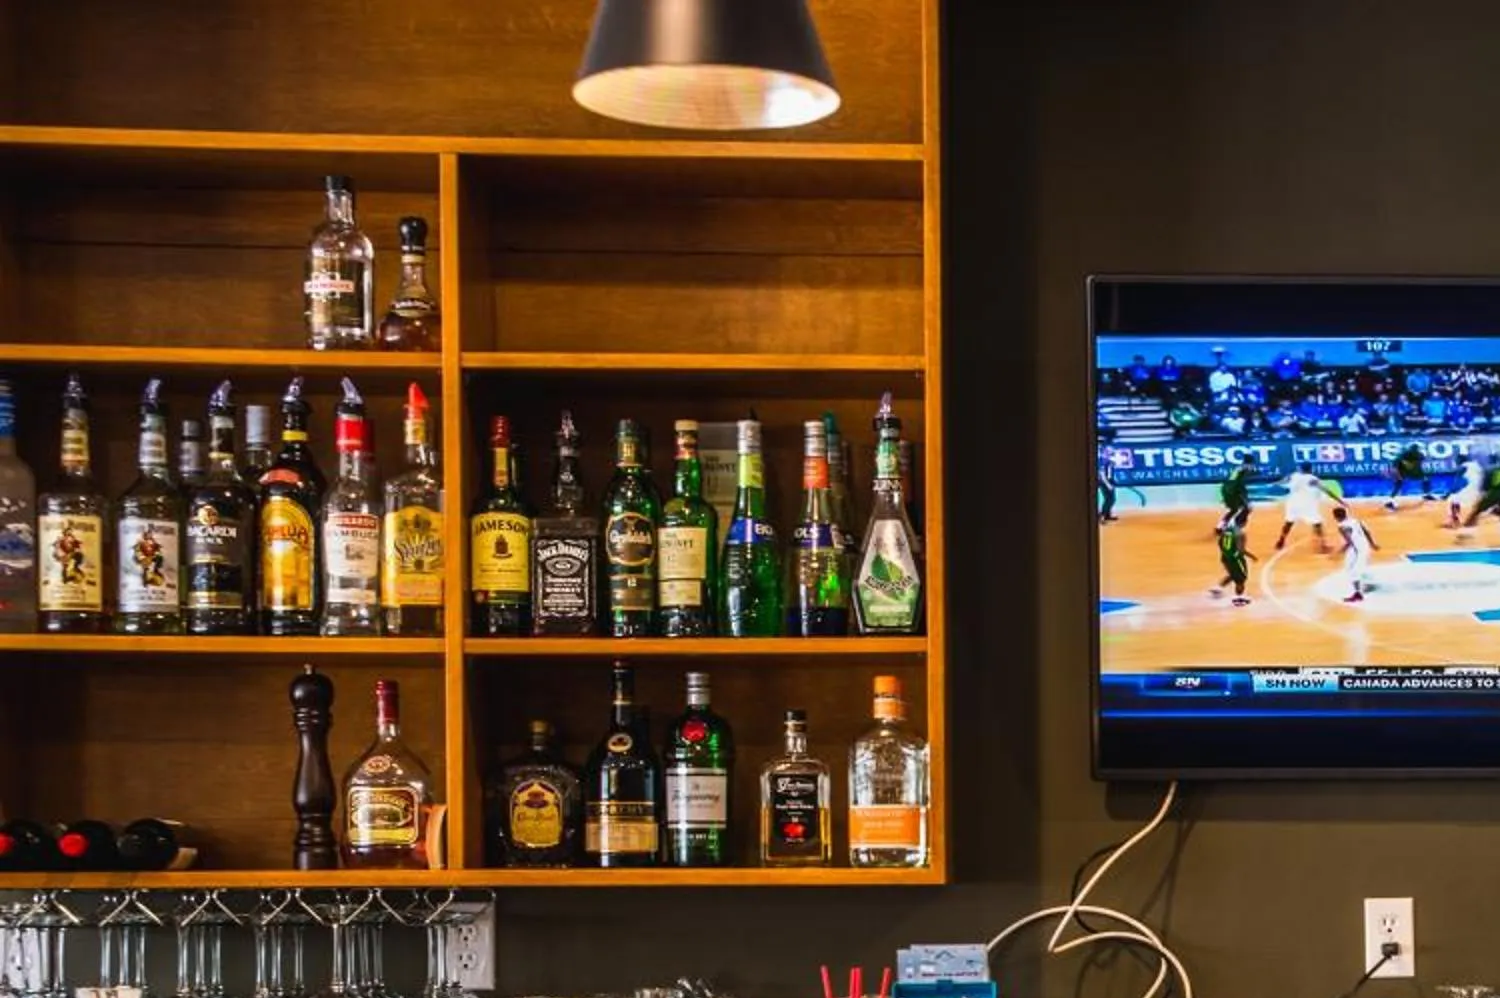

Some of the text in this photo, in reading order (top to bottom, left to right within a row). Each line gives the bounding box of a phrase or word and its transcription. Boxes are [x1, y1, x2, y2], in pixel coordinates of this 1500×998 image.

[1134, 445, 1277, 467] TISSOT
[1291, 677, 1326, 689] NOW
[1342, 677, 1400, 689] CANADA
[1401, 677, 1474, 689] ADVANCES
[1476, 677, 1494, 689] TO
